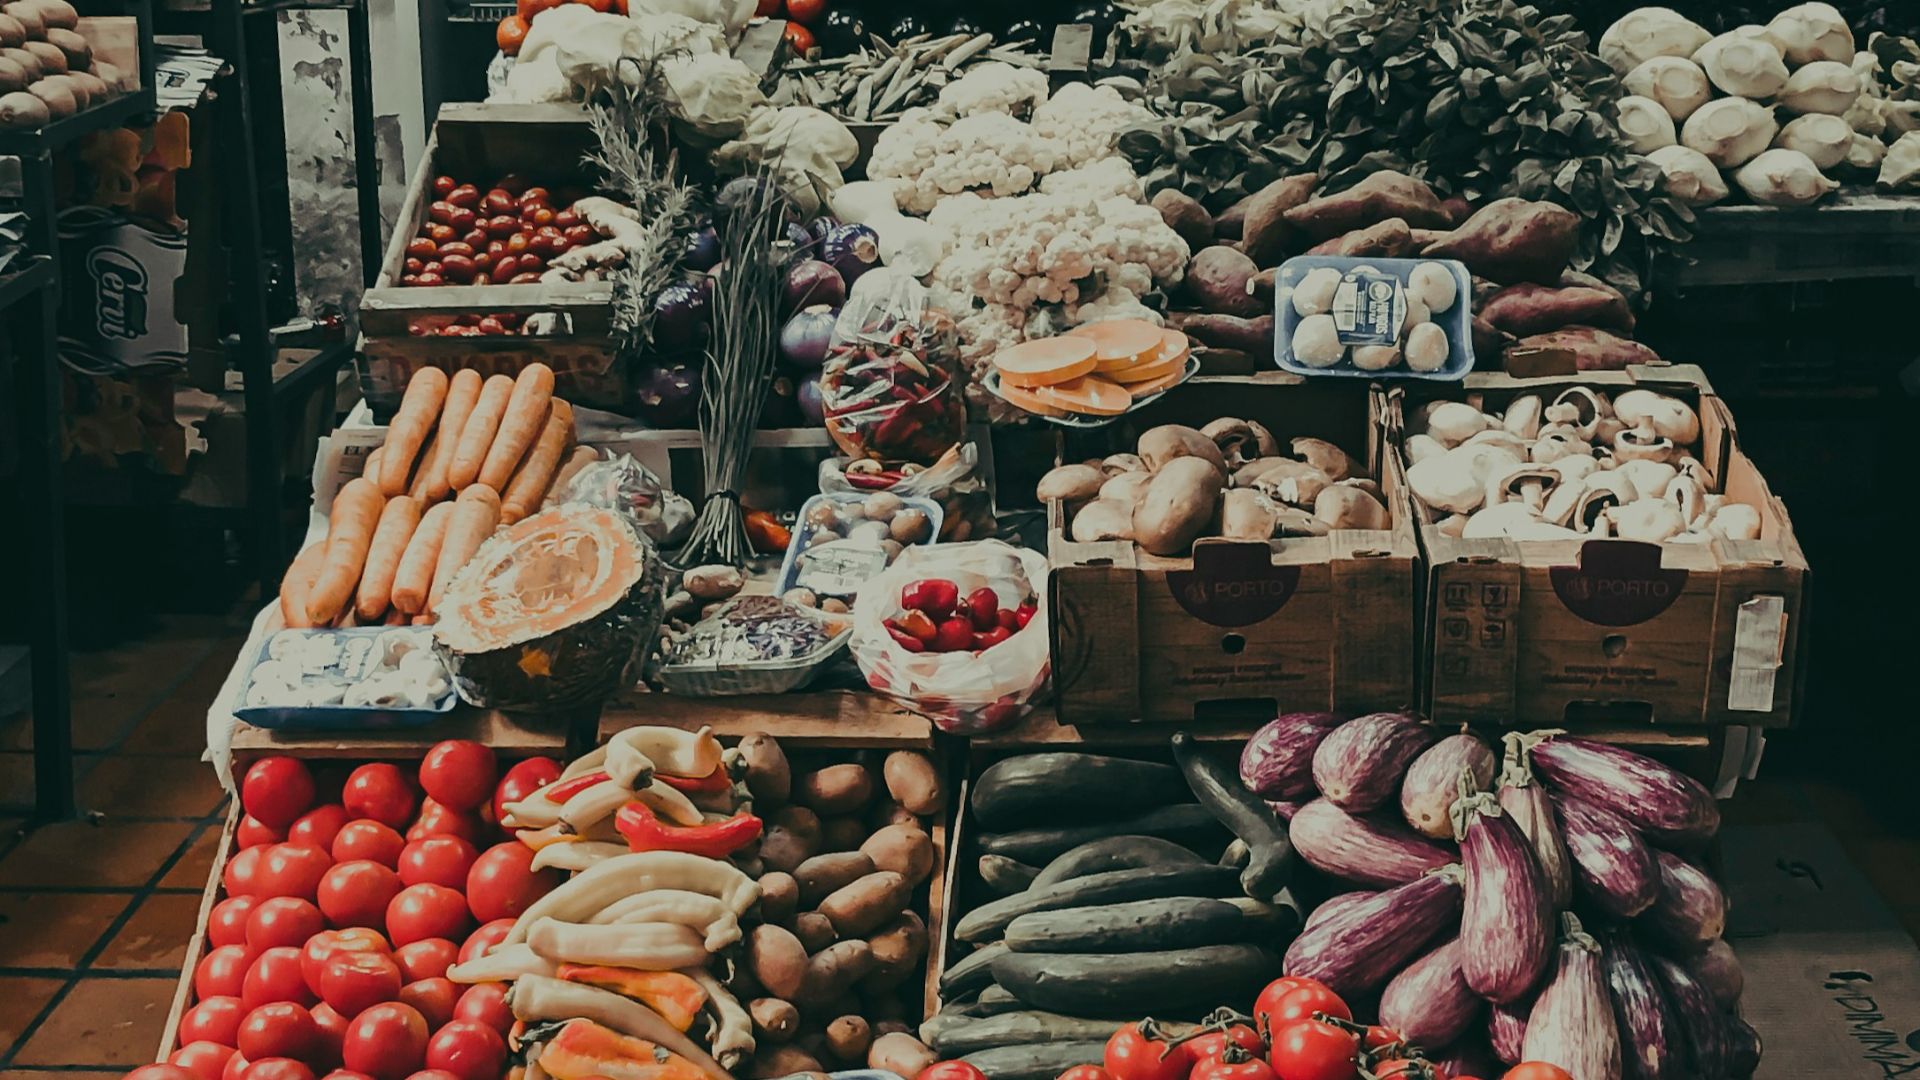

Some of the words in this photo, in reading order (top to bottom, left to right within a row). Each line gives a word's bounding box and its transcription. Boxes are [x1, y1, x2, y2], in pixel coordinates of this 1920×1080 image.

[90, 248, 147, 338] Cervi
[1214, 579, 1284, 599] PORTO
[1597, 578, 1669, 598] PORTO
